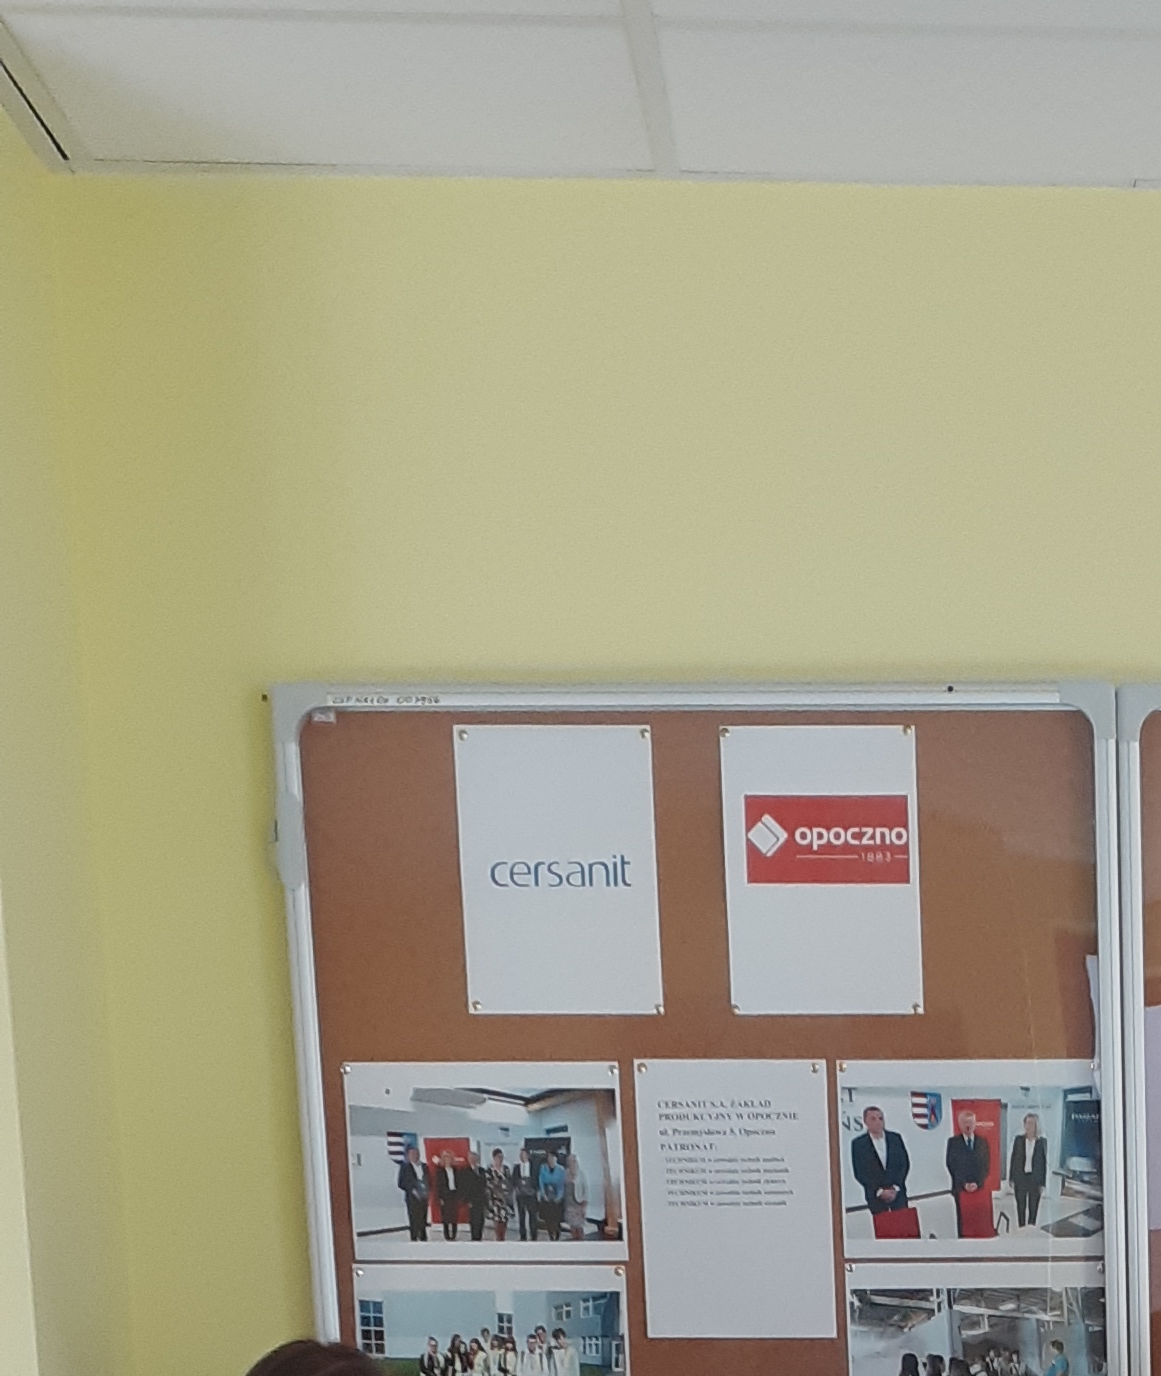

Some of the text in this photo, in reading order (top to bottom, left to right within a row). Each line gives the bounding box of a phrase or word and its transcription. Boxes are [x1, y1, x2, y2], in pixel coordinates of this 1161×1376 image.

[794, 826, 908, 851] opoczno
[861, 851, 892, 862] 1883
[489, 853, 632, 888] cersanit
